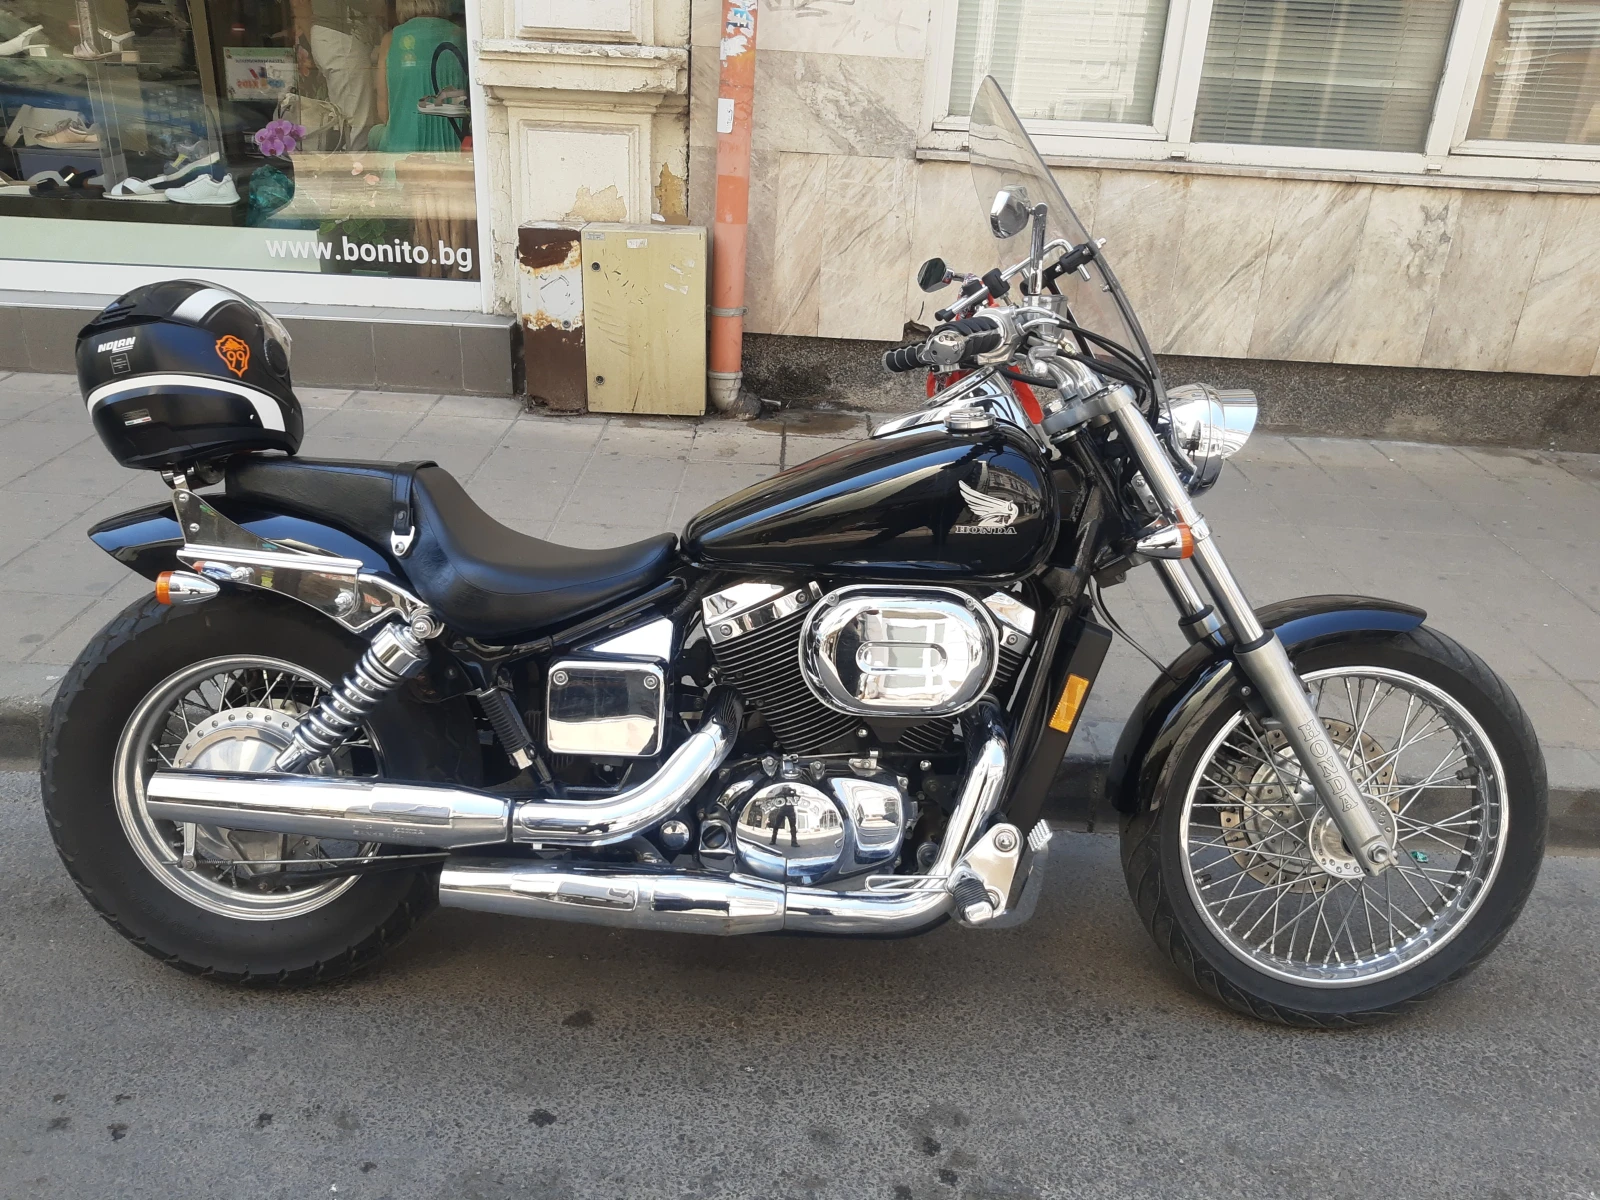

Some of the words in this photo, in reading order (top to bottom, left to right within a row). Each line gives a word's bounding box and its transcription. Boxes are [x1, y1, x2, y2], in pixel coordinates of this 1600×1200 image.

[265, 236, 473, 272] www.bonito.bg
[97, 336, 136, 353] NOLAN
[226, 350, 246, 368] 99
[955, 525, 1018, 535] HONDA
[1298, 719, 1359, 813] HONDA
